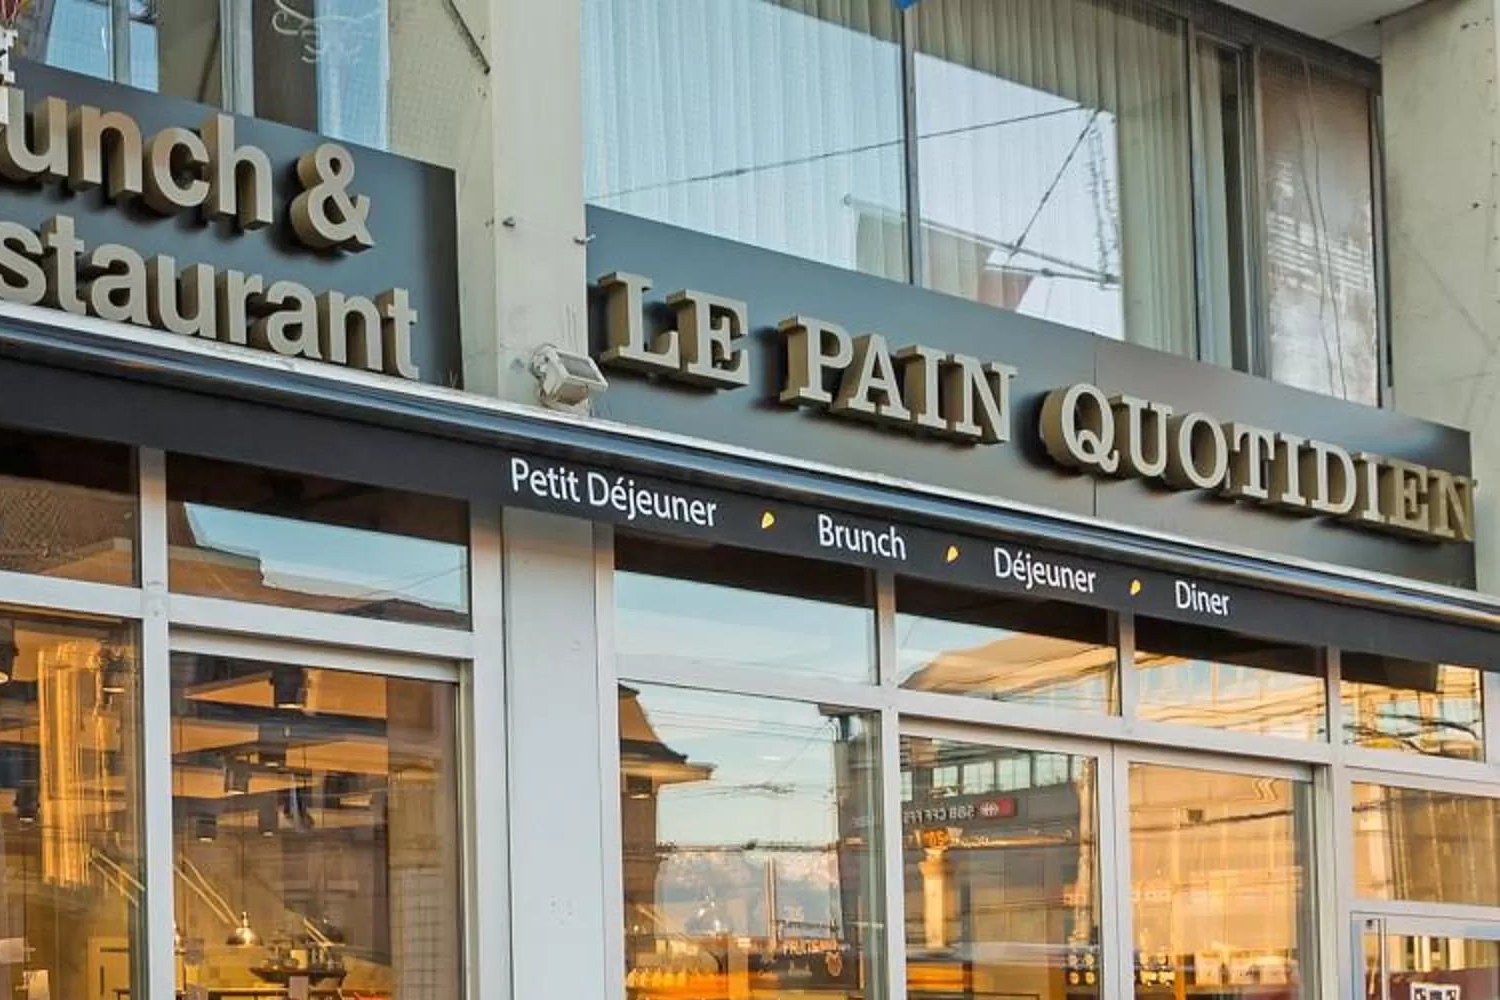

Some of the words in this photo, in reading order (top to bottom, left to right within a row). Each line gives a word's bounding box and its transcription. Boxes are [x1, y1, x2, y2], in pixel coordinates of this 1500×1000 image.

[292, 142, 376, 254] &
[600, 271, 750, 390] LE
[778, 314, 1018, 443] PAIN
[1040, 383, 1477, 542] QUOTIDIEN
[510, 456, 581, 504] Petit
[587, 471, 718, 528] Déjeuner
[817, 513, 907, 561] Brunch
[993, 546, 1097, 594] Déjeuner
[1175, 579, 1230, 616] Diner
